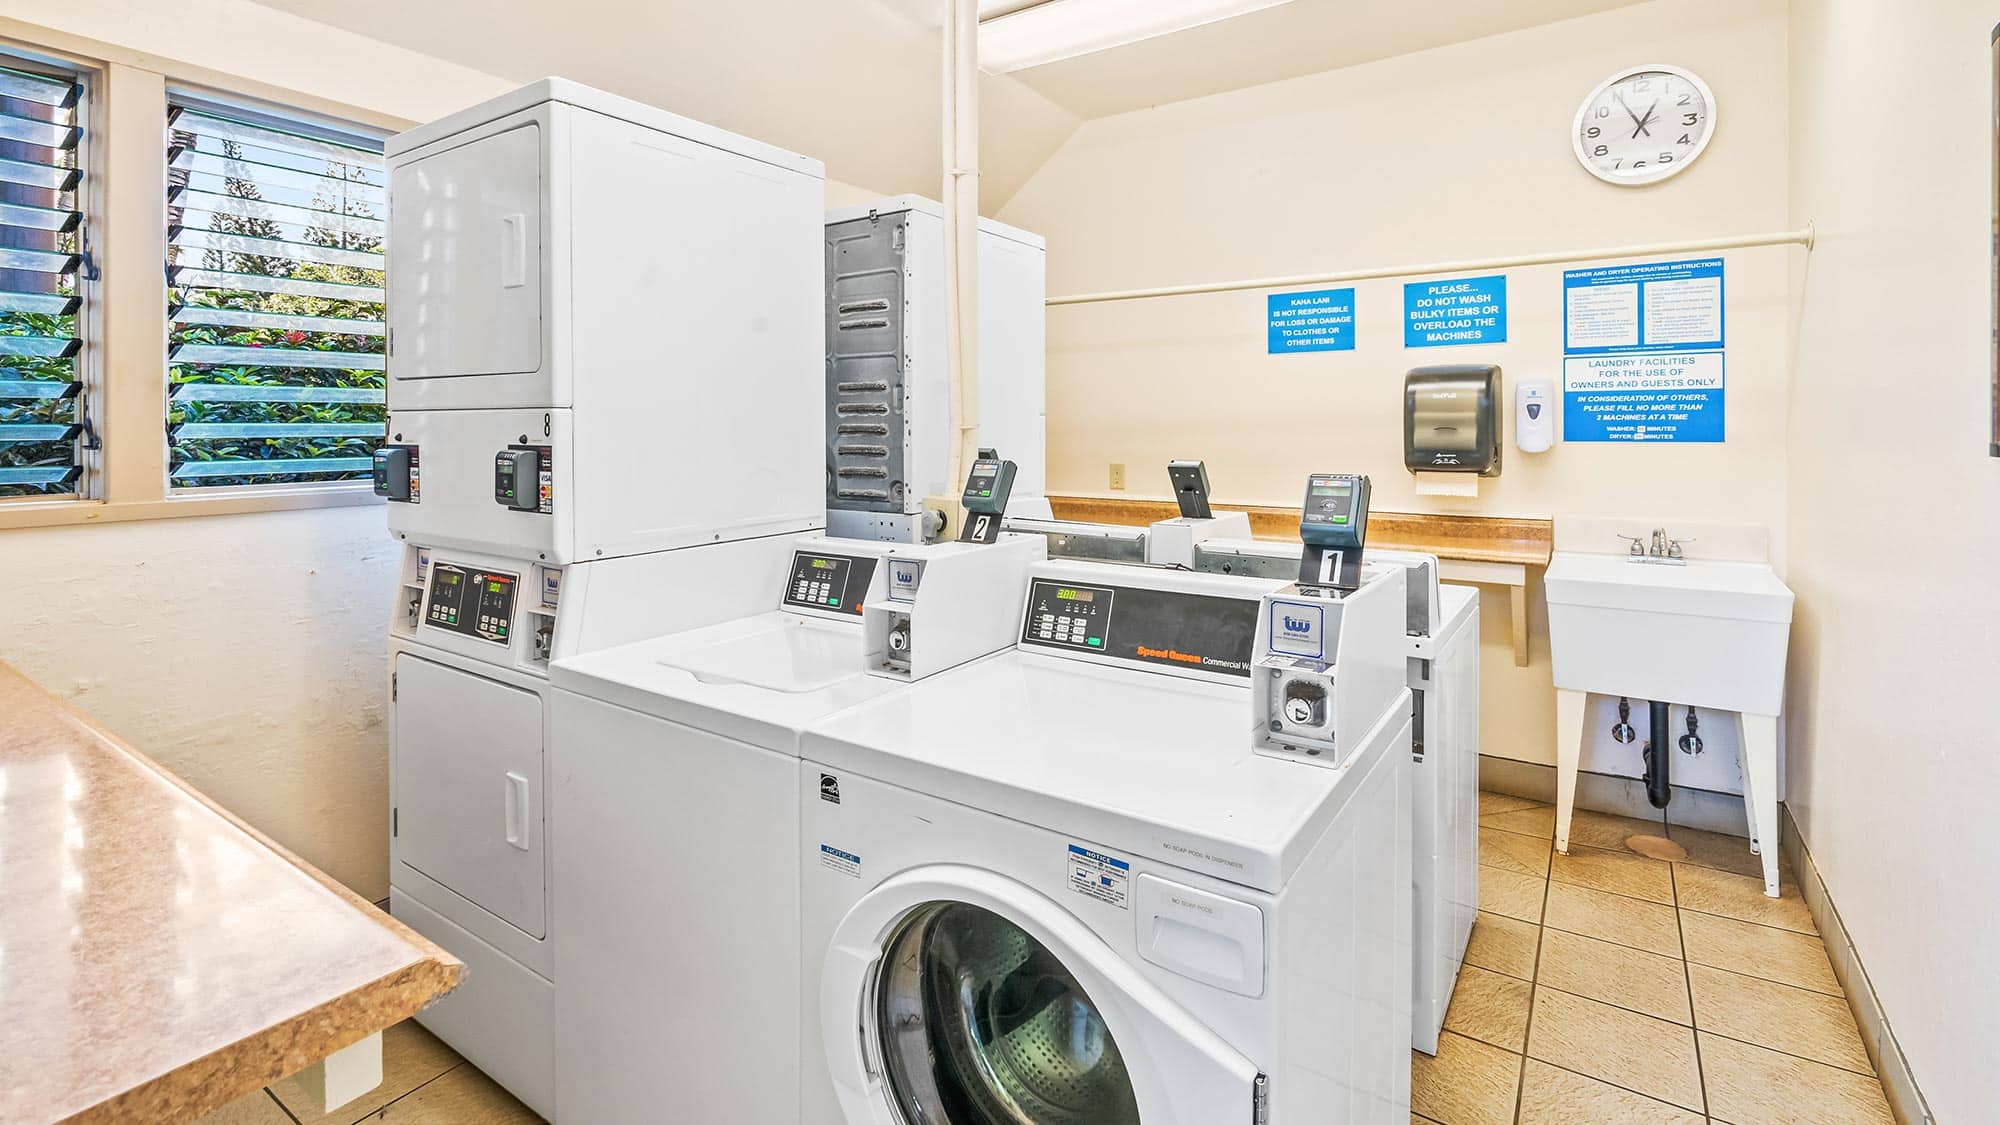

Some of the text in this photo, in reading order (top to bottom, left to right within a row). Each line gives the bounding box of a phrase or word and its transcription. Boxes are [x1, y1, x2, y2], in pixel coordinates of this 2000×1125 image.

[1632, 81, 1650, 93] 12
[1677, 93, 1690, 106] 2
[1595, 106, 1609, 119] 10
[1682, 113, 1698, 126] 3
[1587, 127, 1600, 138] 9
[1677, 133, 1690, 144] 4
[1594, 145, 1608, 156] 8
[1611, 158, 1623, 170] 7
[1658, 152, 1673, 164] 5
[1671, 262, 1722, 270] INSTRUCTIONS
[1429, 284, 1479, 295] PLEASE...
[1417, 294, 1491, 307] DO NOT WASH
[1298, 306, 1349, 315] RESPONSIBLE
[1411, 305, 1499, 319] BULKY ITEMS OR
[1320, 316, 1352, 324] DAMAGE
[1414, 317, 1496, 330] OVERLOAD THE
[1427, 330, 1482, 341] MACHINES
[1589, 357, 1695, 368] LAUNDRY FACILITIES
[1571, 381, 1614, 389] OWNERS
[544, 413, 550, 437] 8
[974, 518, 987, 539] 2
[1326, 552, 1338, 582] 1
[1138, 646, 1168, 658] Speed
[1169, 650, 1201, 663] Queen
[1203, 657, 1240, 669] Commercial
[1086, 851, 1110, 864] NOTICE
[1188, 849, 1203, 858] PODS
[1212, 856, 1243, 870] DISPENSER
